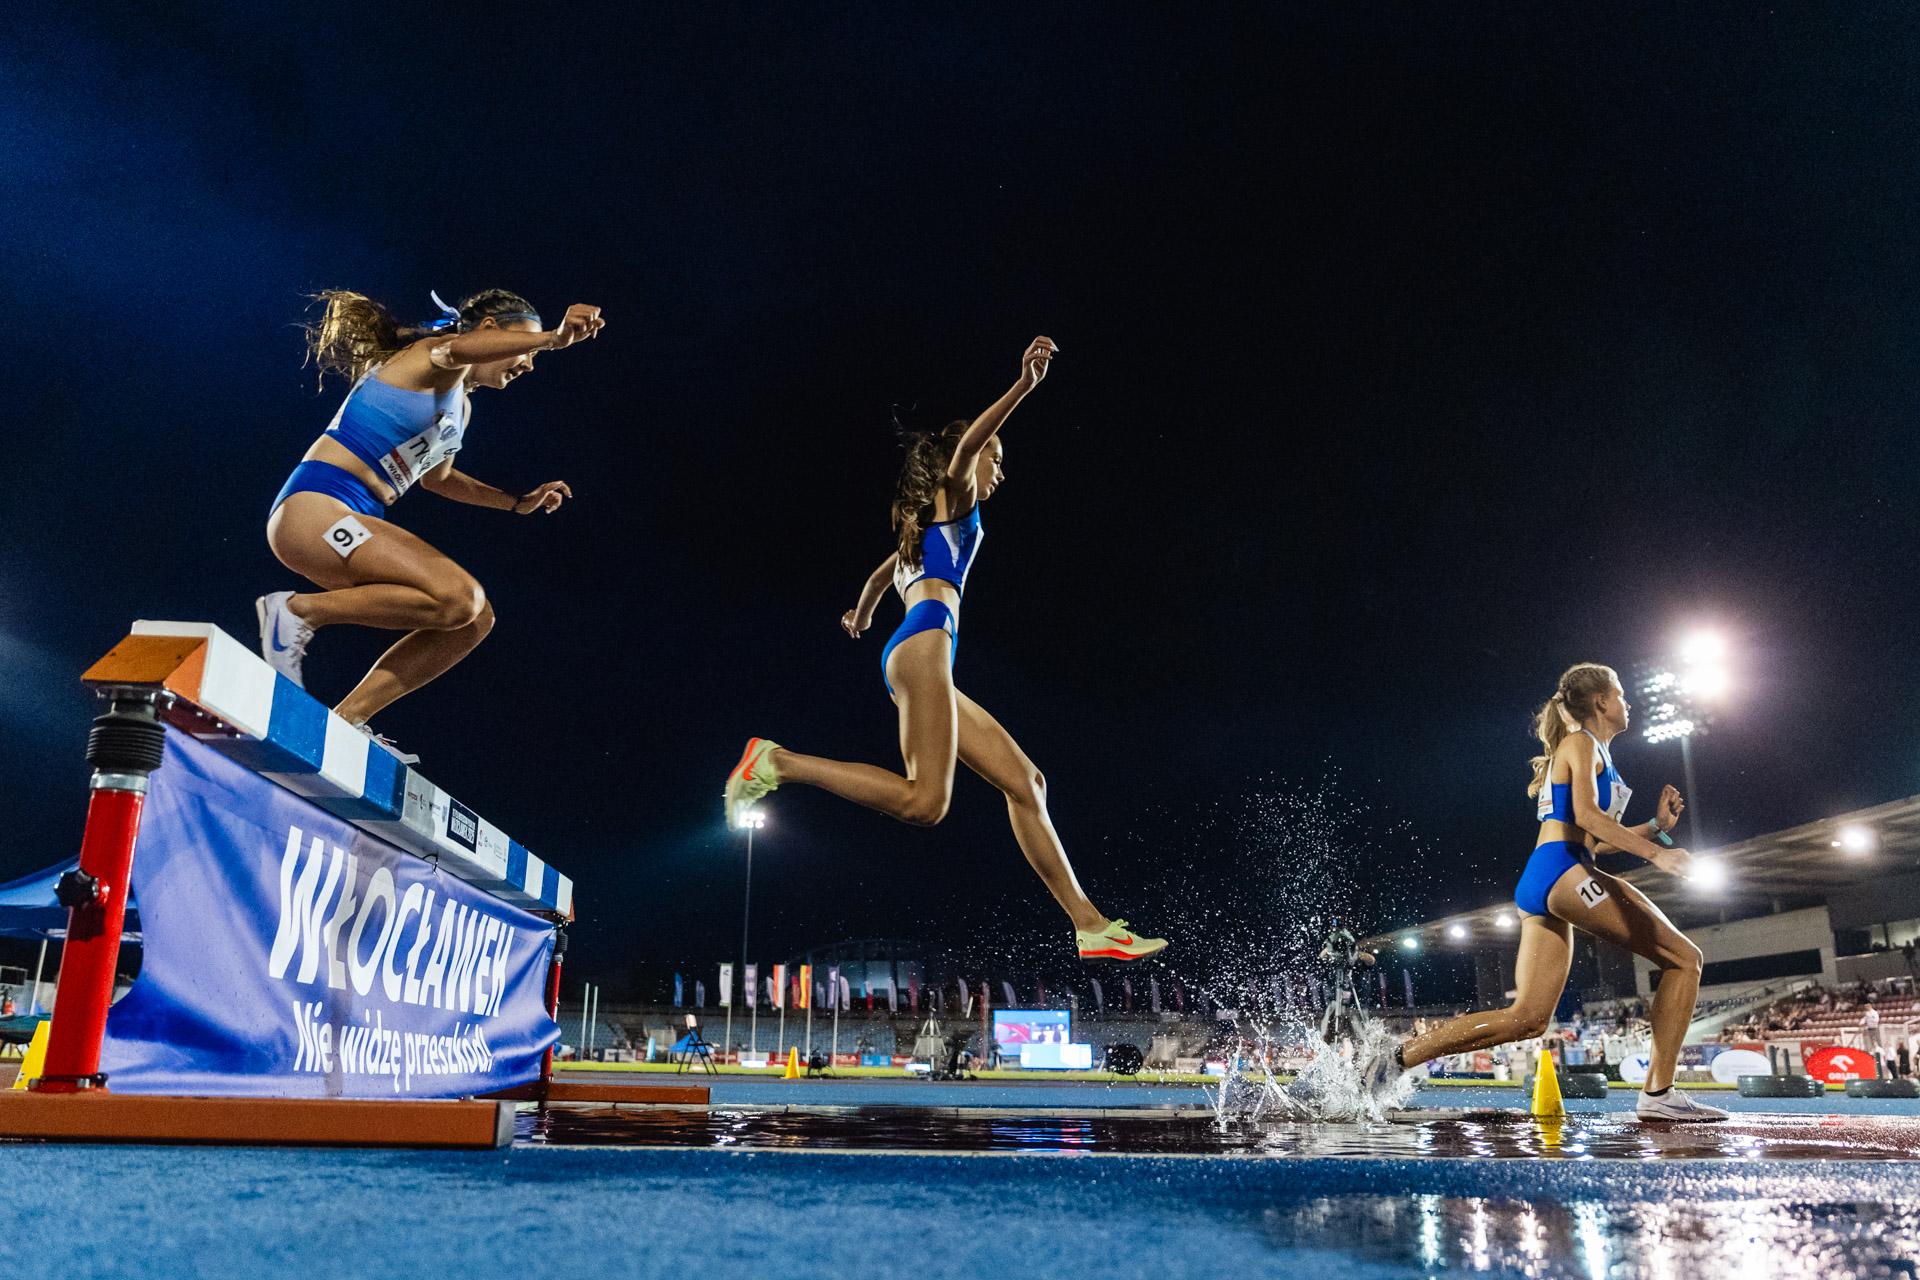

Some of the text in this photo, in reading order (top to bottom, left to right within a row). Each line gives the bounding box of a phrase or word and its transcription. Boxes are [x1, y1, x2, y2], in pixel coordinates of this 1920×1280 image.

[333, 528, 353, 547] 9
[1580, 880, 1604, 902] 10
[269, 825, 515, 1018] WŁOCŁAWEK
[293, 1000, 493, 1093] Nie widzę przeszkód!
[1828, 1072, 1860, 1081] ORLEN
